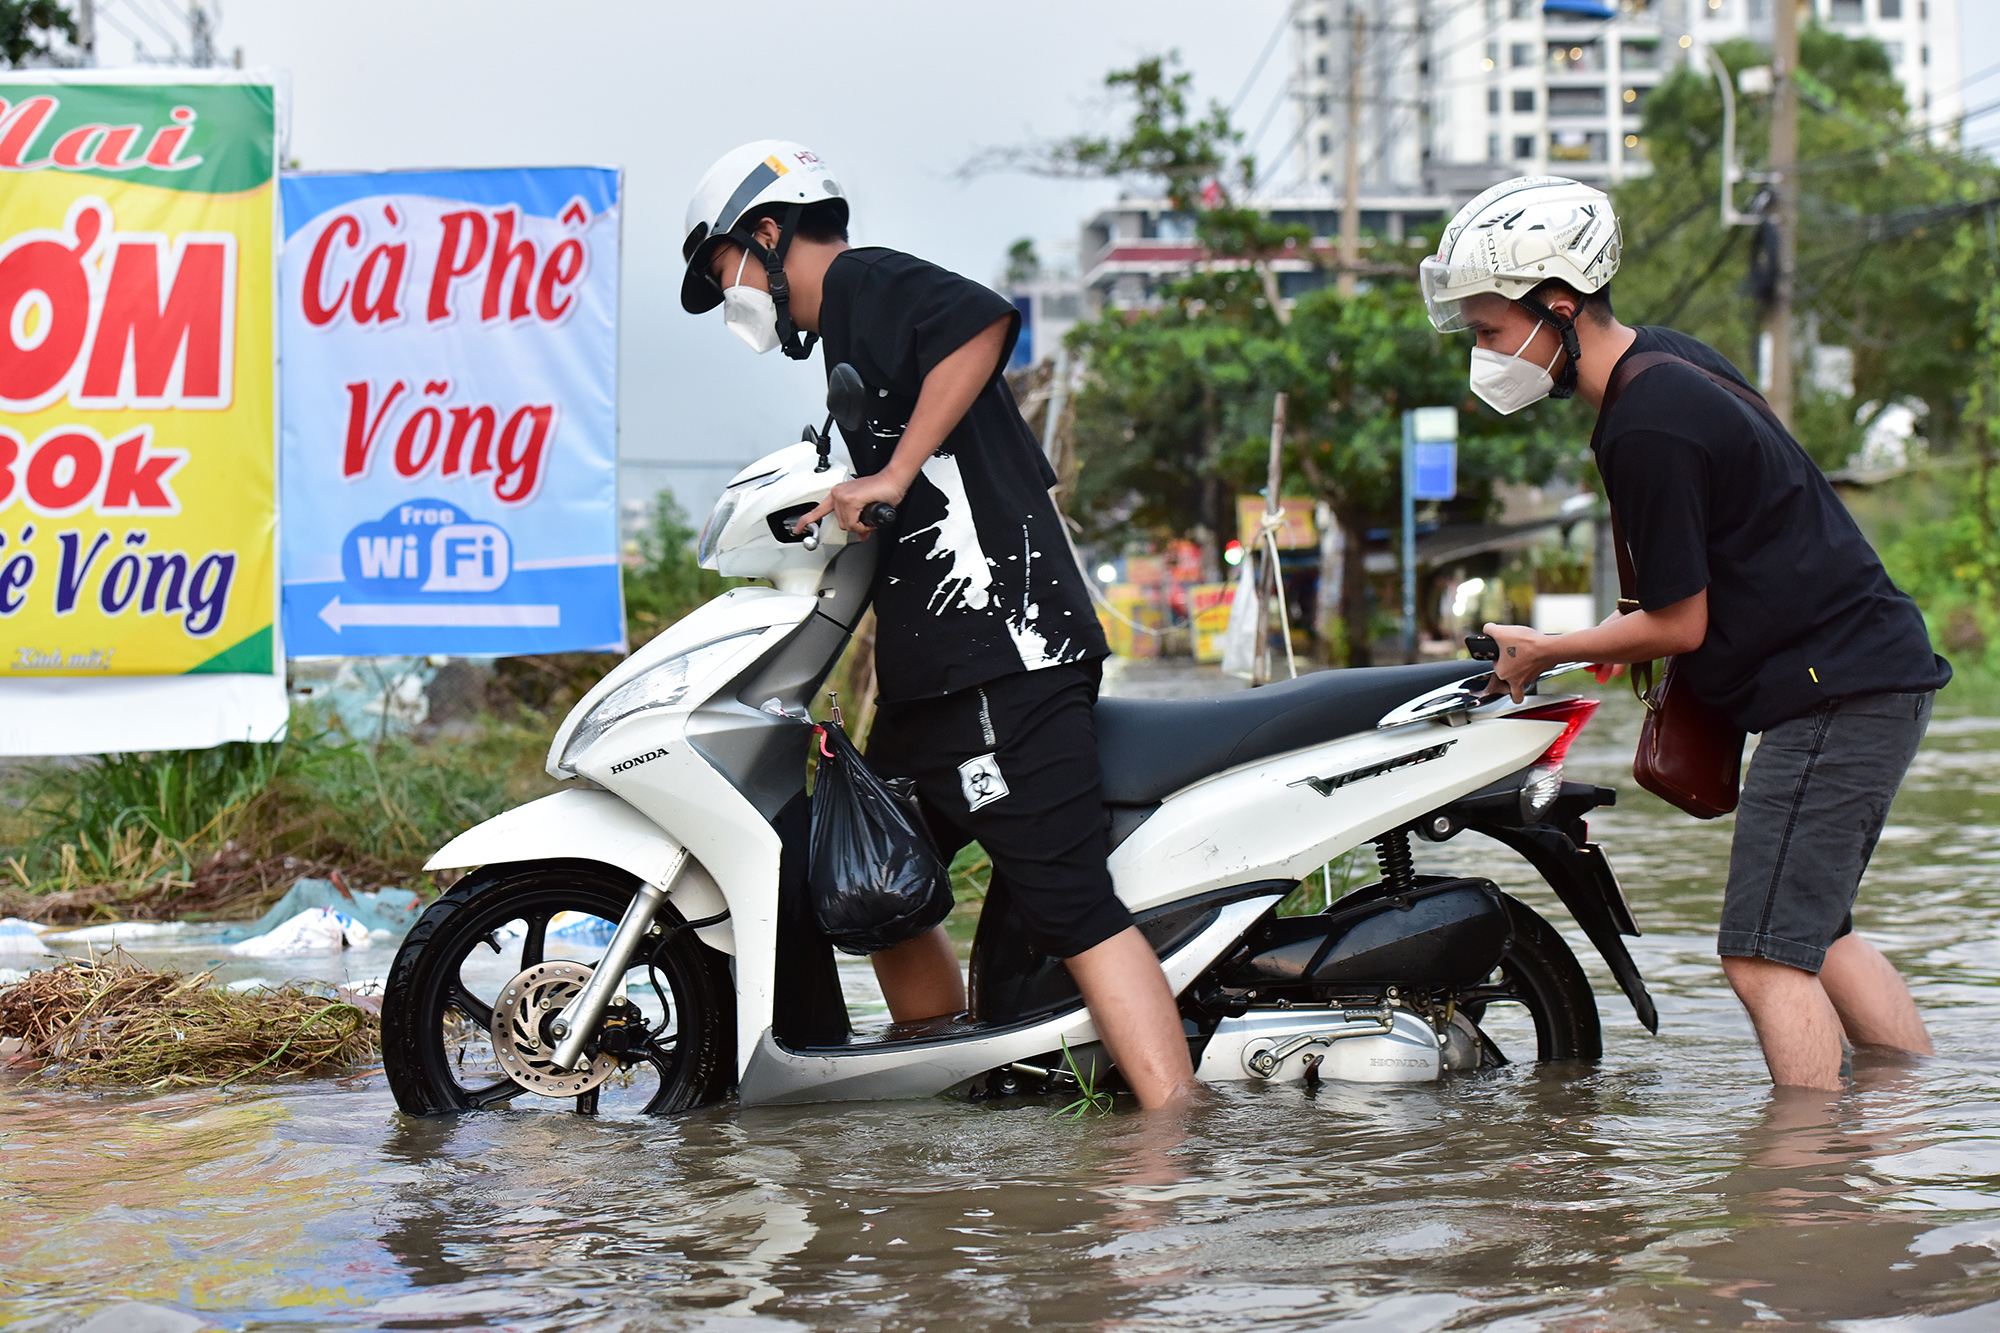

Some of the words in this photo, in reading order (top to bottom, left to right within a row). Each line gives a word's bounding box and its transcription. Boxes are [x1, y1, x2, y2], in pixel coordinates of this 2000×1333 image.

[302, 204, 407, 326] Cà
[427, 202, 585, 323] Phê
[344, 380, 552, 503] Võng
[401, 505, 455, 525] Free
[57, 532, 235, 636] Võng
[610, 748, 669, 775] HONDA
[1369, 1057, 1431, 1069] HONDA
